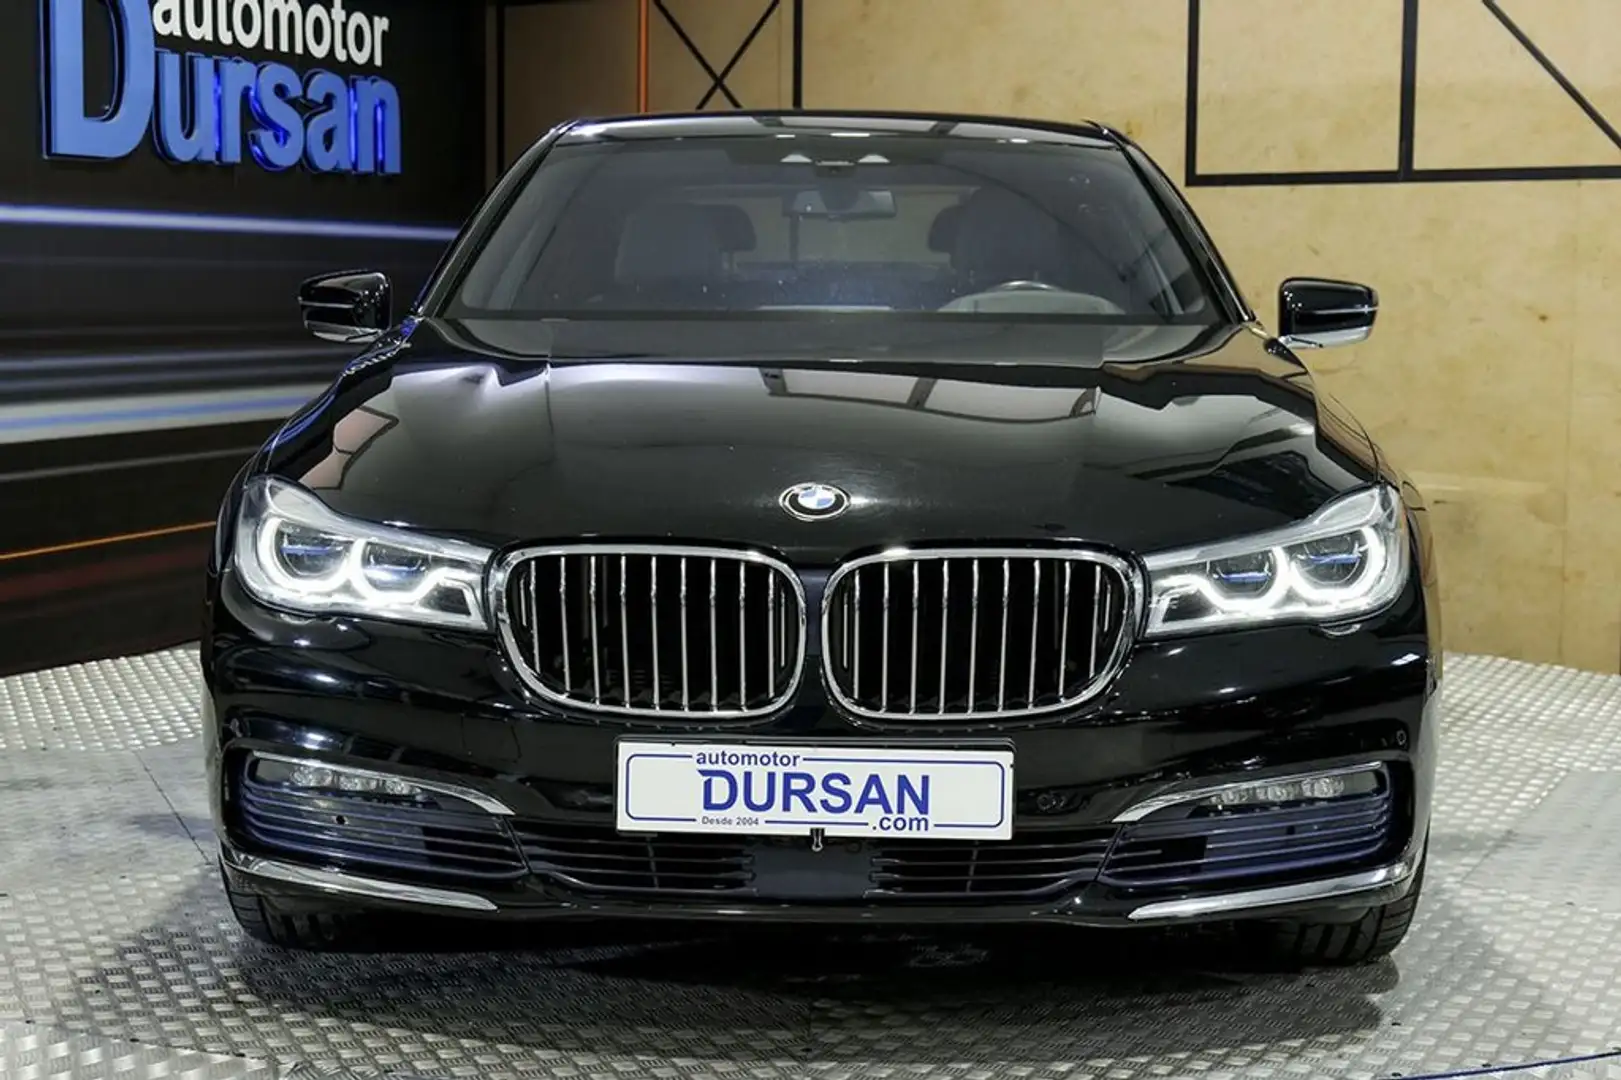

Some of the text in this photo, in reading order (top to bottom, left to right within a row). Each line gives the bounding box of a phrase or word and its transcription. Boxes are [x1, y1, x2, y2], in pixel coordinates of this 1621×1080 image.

[152, 0, 389, 67] automotor
[41, 0, 401, 174] Dursan
[696, 750, 800, 768] automotor
[698, 769, 930, 815] DURSAN
[701, 815, 760, 827] Desde 2004
[871, 815, 930, 832] .com
